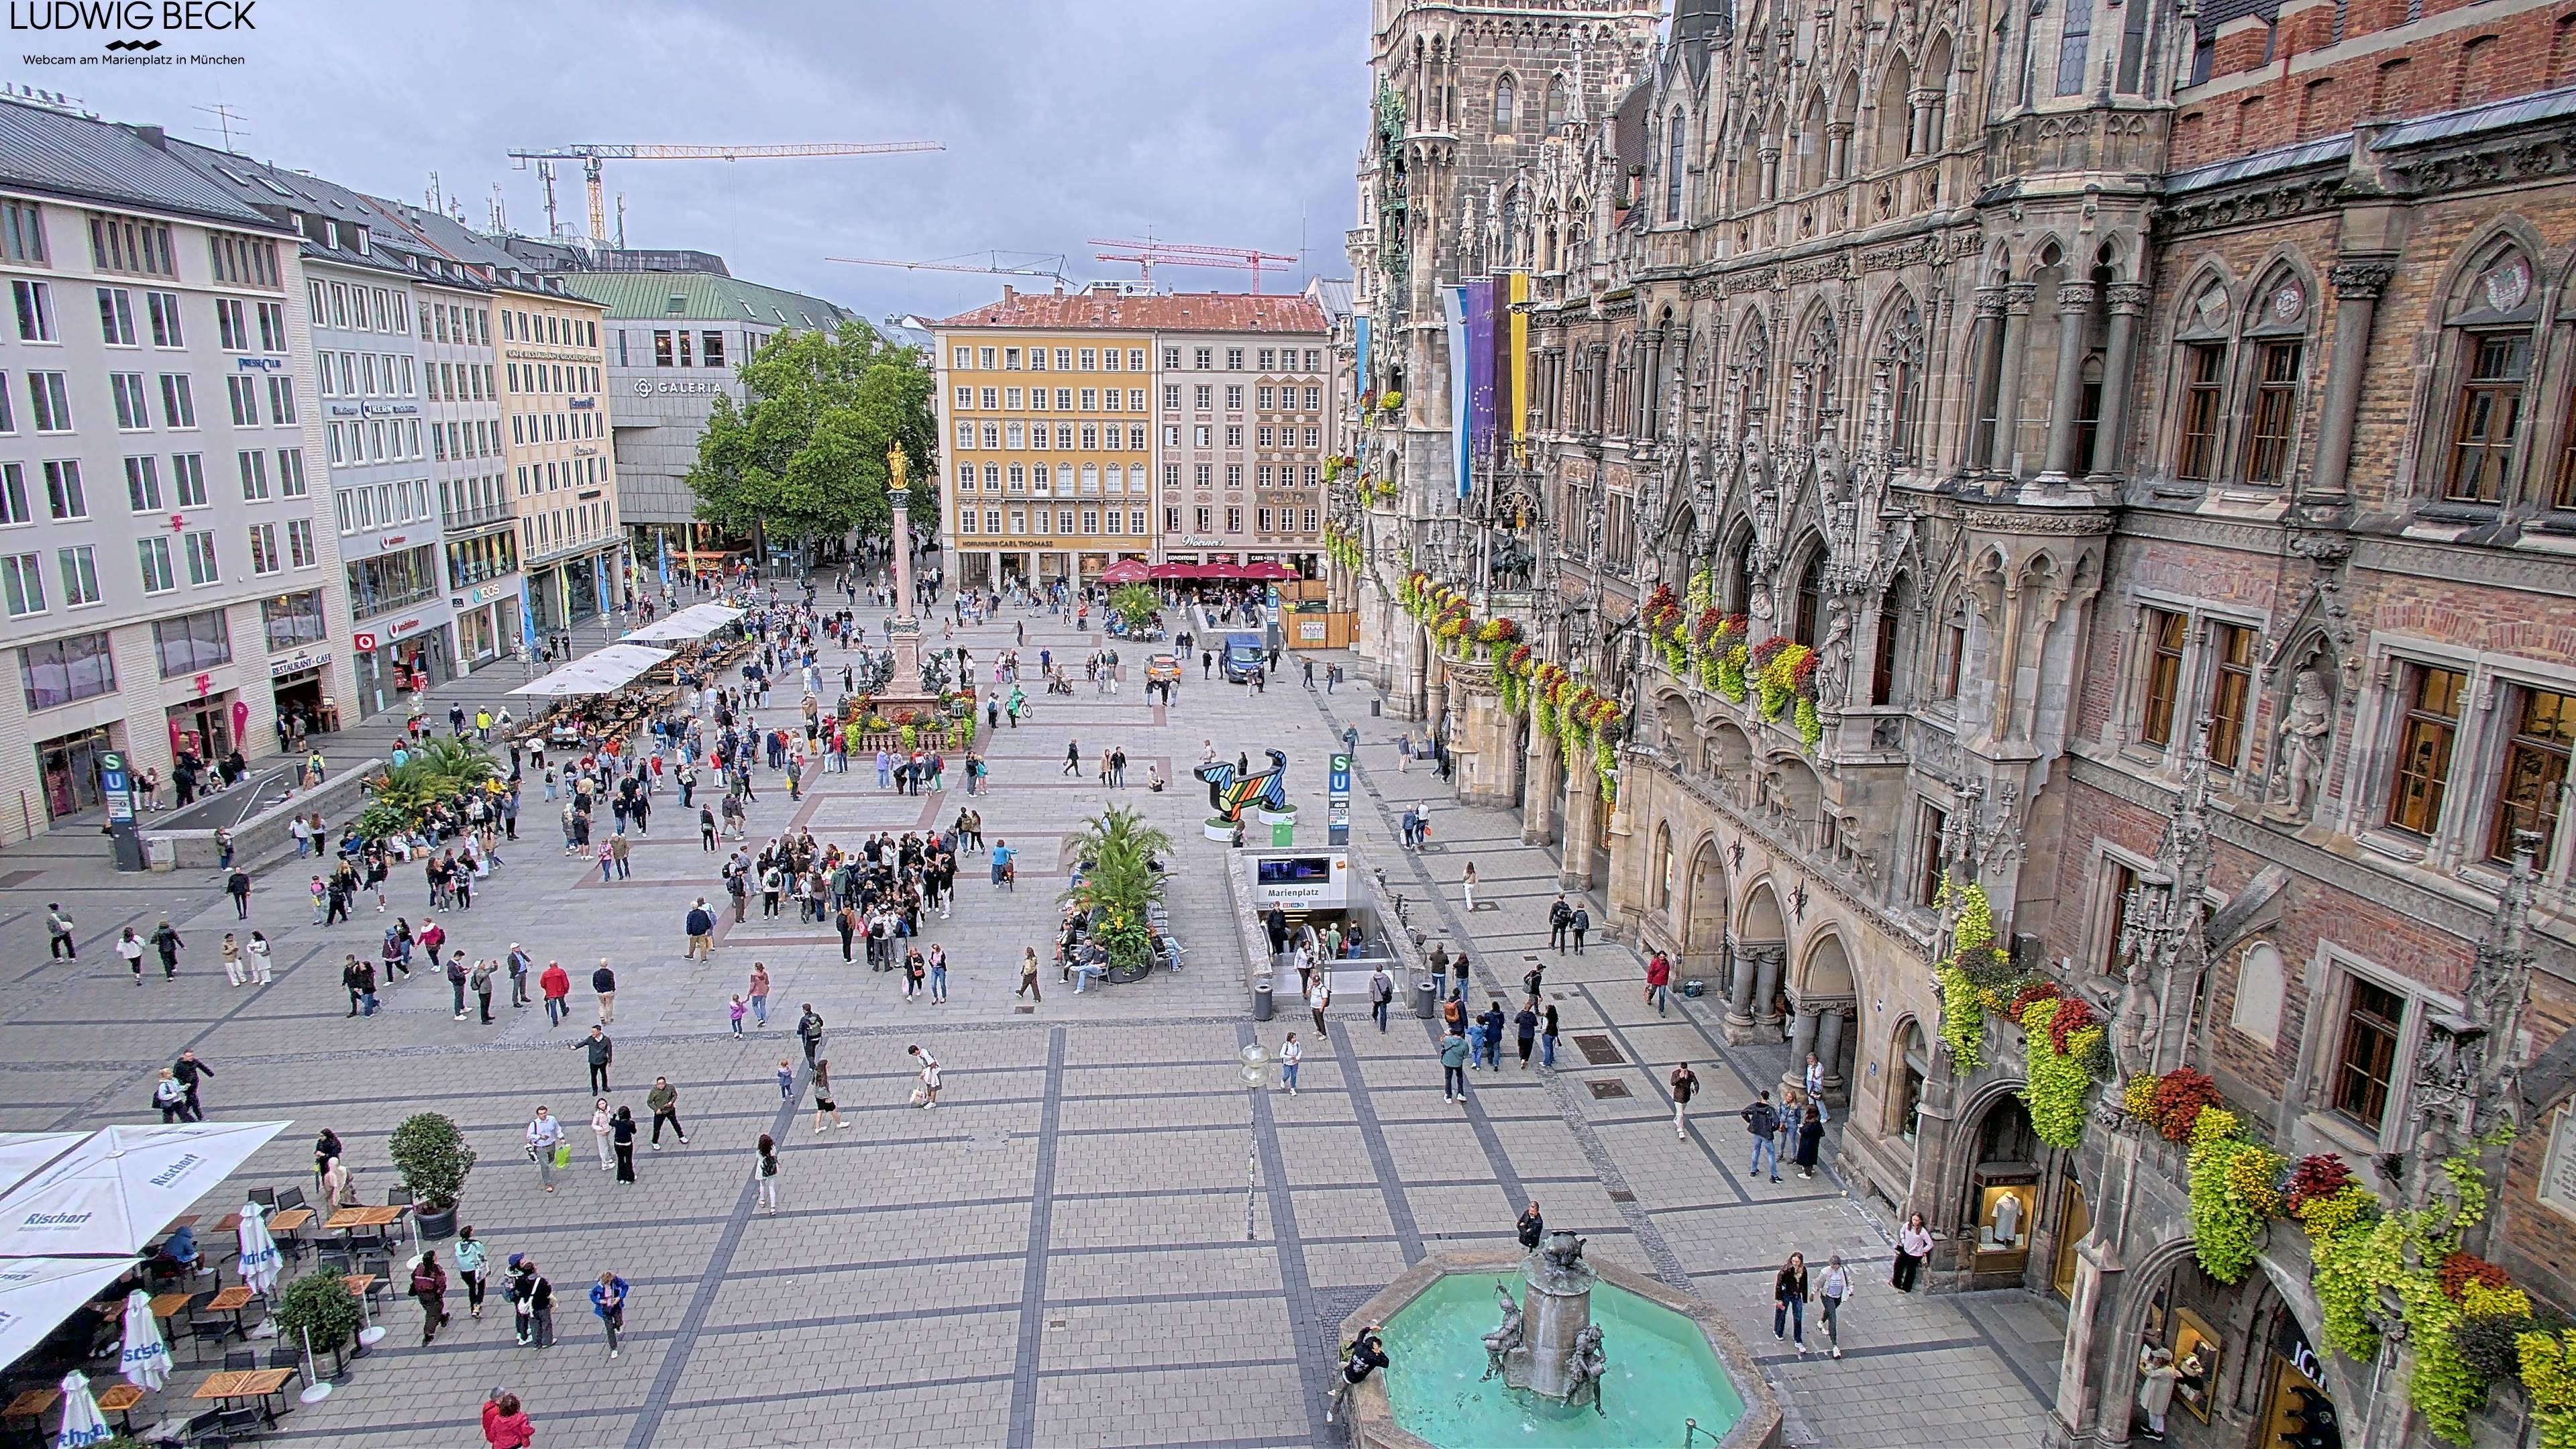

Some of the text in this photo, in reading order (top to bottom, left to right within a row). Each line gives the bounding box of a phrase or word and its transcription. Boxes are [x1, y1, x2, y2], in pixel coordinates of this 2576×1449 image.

[658, 382, 722, 393] GALERIA
[1181, 535, 1224, 547] Woerner's
[480, 584, 500, 600] IQOS
[1269, 588, 1277, 596] S
[1269, 598, 1276, 606] U
[272, 658, 312, 676] RESTAURANT
[105, 754, 119, 769] S
[1334, 756, 1346, 771] S
[108, 774, 121, 789] U
[1334, 775, 1346, 790] U
[1268, 889, 1319, 898] Marienplatz
[150, 1154, 199, 1185] Rischart
[23, 1212, 93, 1224] Rischart
